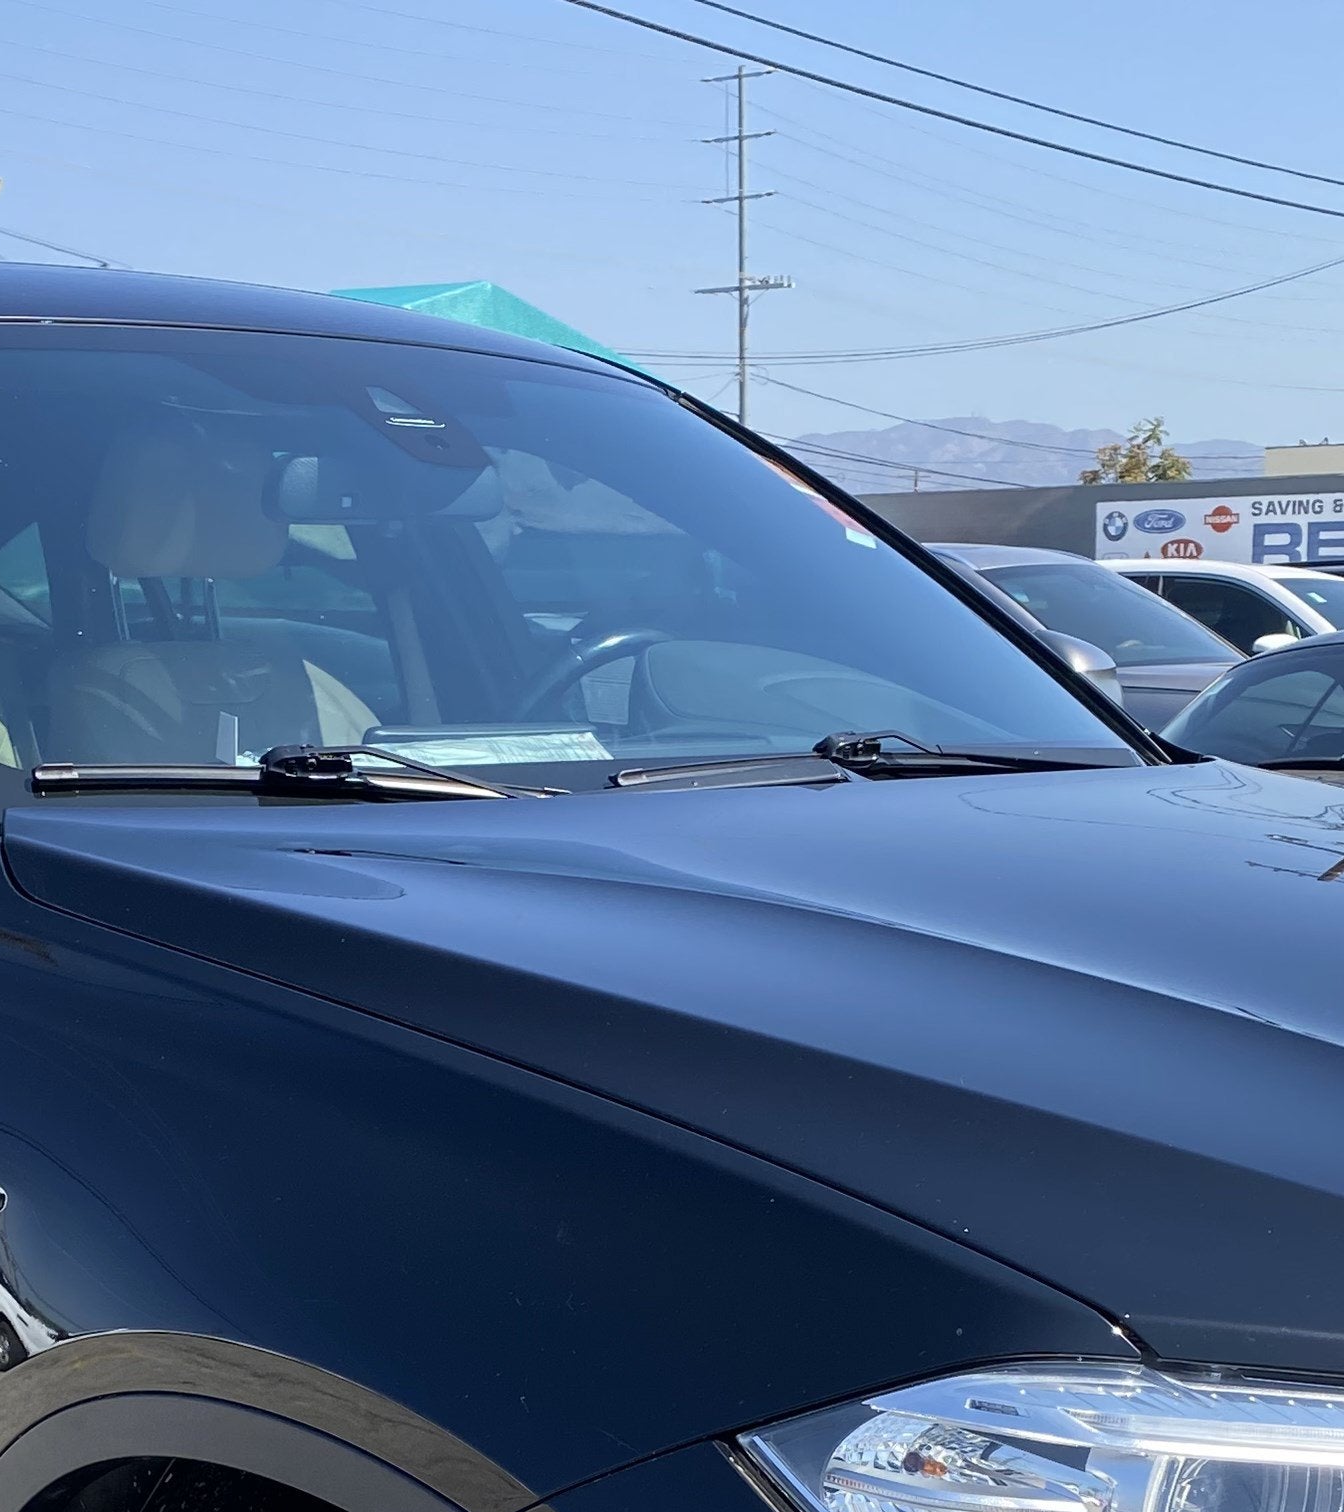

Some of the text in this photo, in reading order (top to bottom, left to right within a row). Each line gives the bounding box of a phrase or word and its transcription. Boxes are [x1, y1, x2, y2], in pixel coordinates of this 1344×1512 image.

[1251, 499, 1324, 517] SAVING
[1333, 499, 1344, 513] &
[1206, 514, 1239, 525] NISSAN
[1167, 542, 1197, 557] KIA
